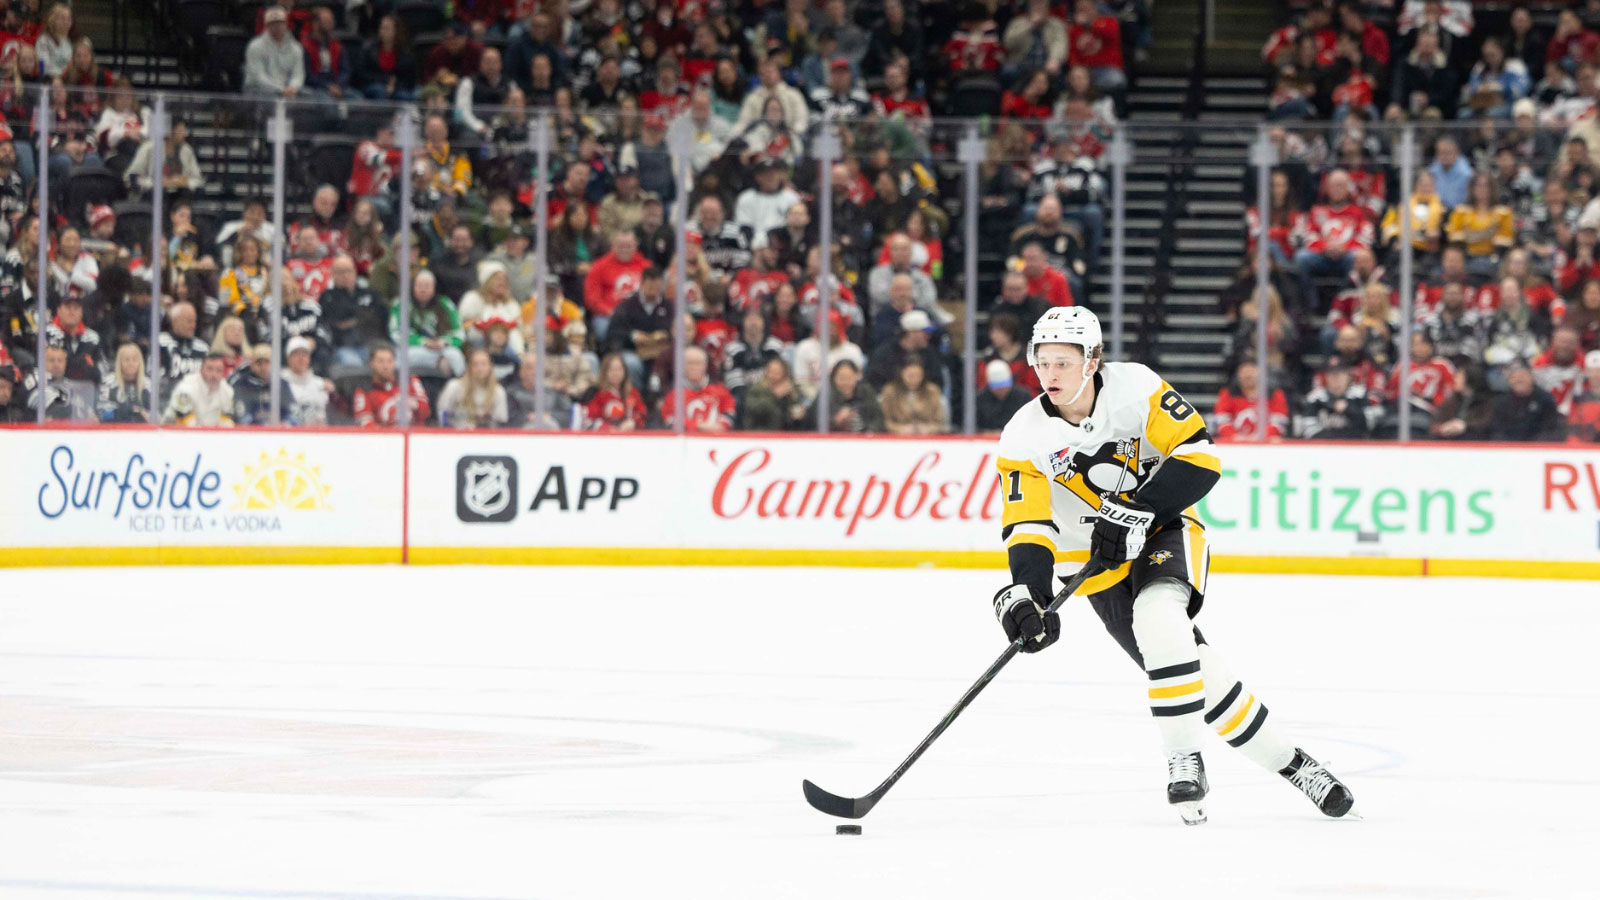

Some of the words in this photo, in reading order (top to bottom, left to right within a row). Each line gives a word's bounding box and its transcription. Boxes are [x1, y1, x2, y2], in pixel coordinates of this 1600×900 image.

[38, 445, 221, 518] Surfside
[1197, 468, 1494, 535] Citizens
[129, 515, 165, 532] ICED
[172, 515, 203, 532] TEA
[224, 515, 282, 532] VODKA
